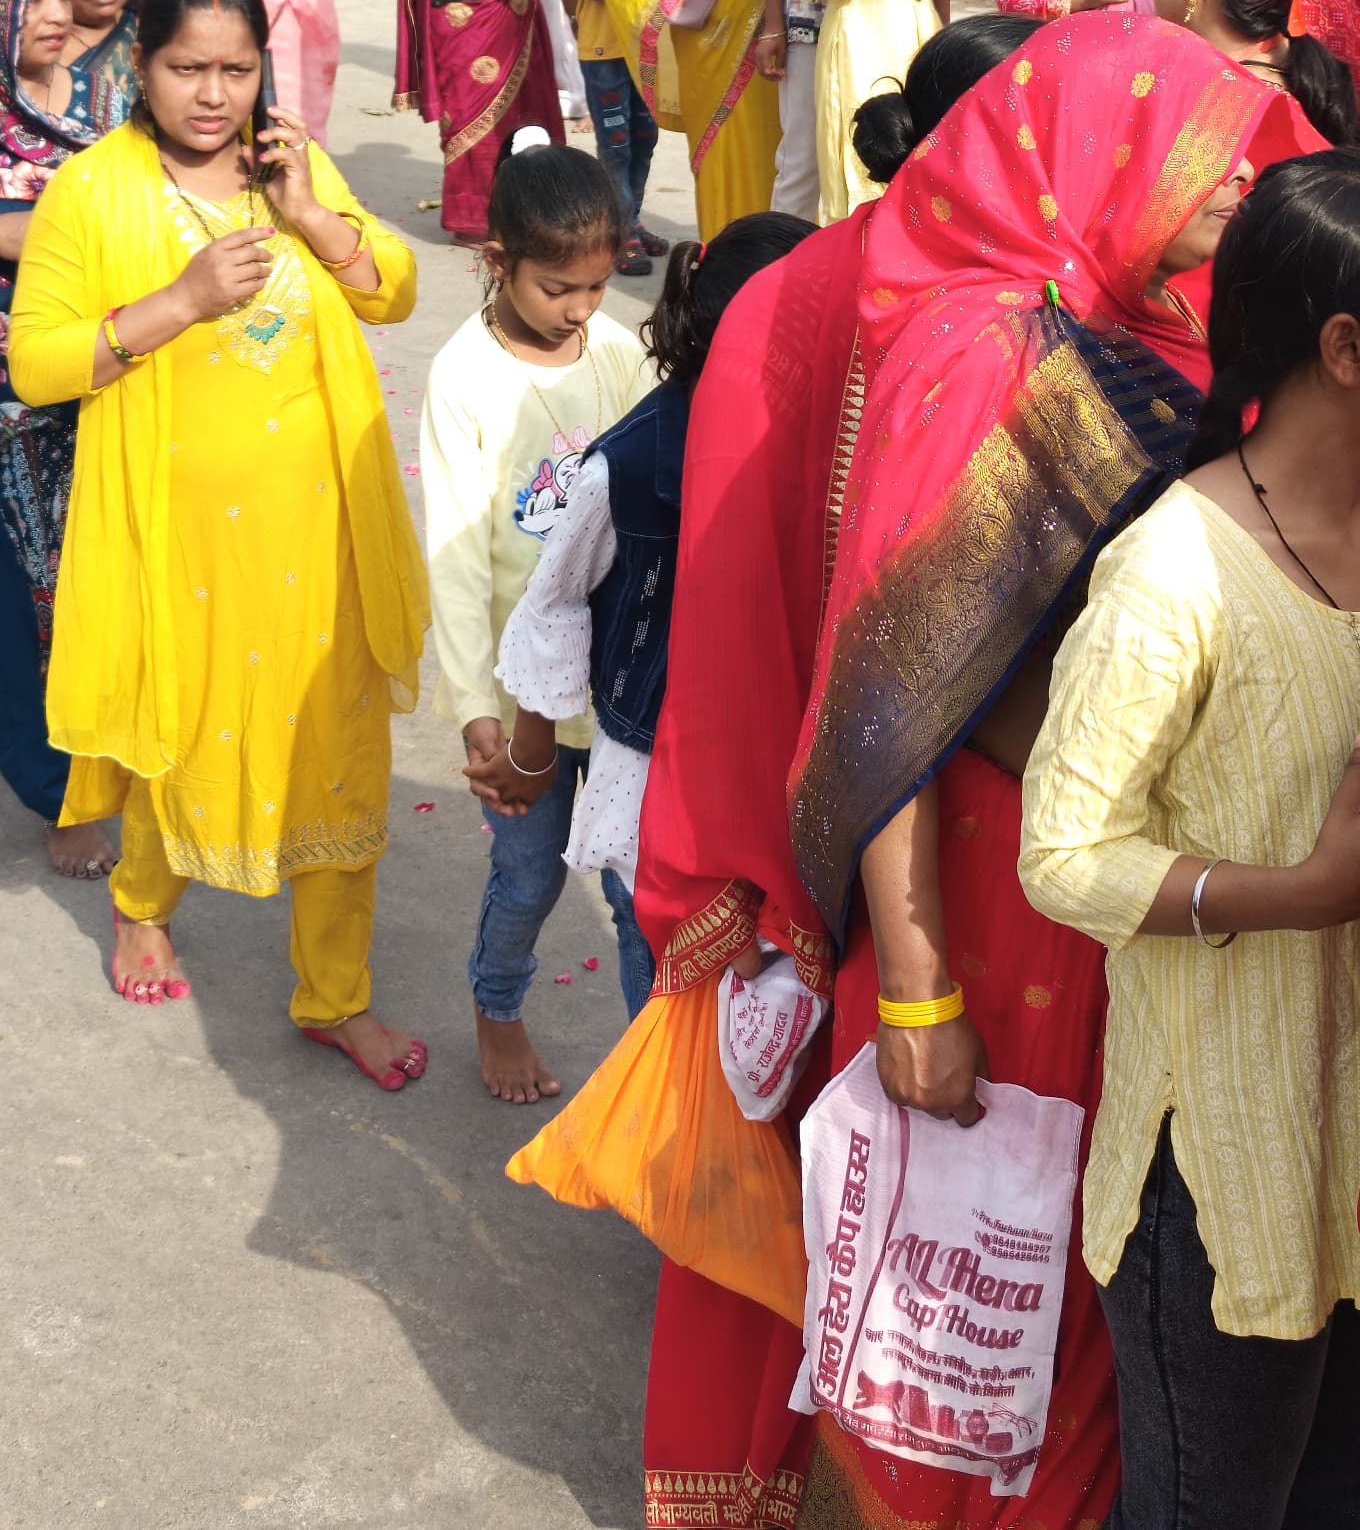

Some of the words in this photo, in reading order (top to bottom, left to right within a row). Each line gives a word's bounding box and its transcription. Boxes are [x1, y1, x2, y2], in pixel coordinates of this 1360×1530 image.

[772, 1011, 788, 1041] यादव
[839, 1127, 872, 1217] हाउस
[937, 1246, 1045, 1312] Hera
[892, 1282, 939, 1333] Cap
[936, 1303, 1025, 1350] House
